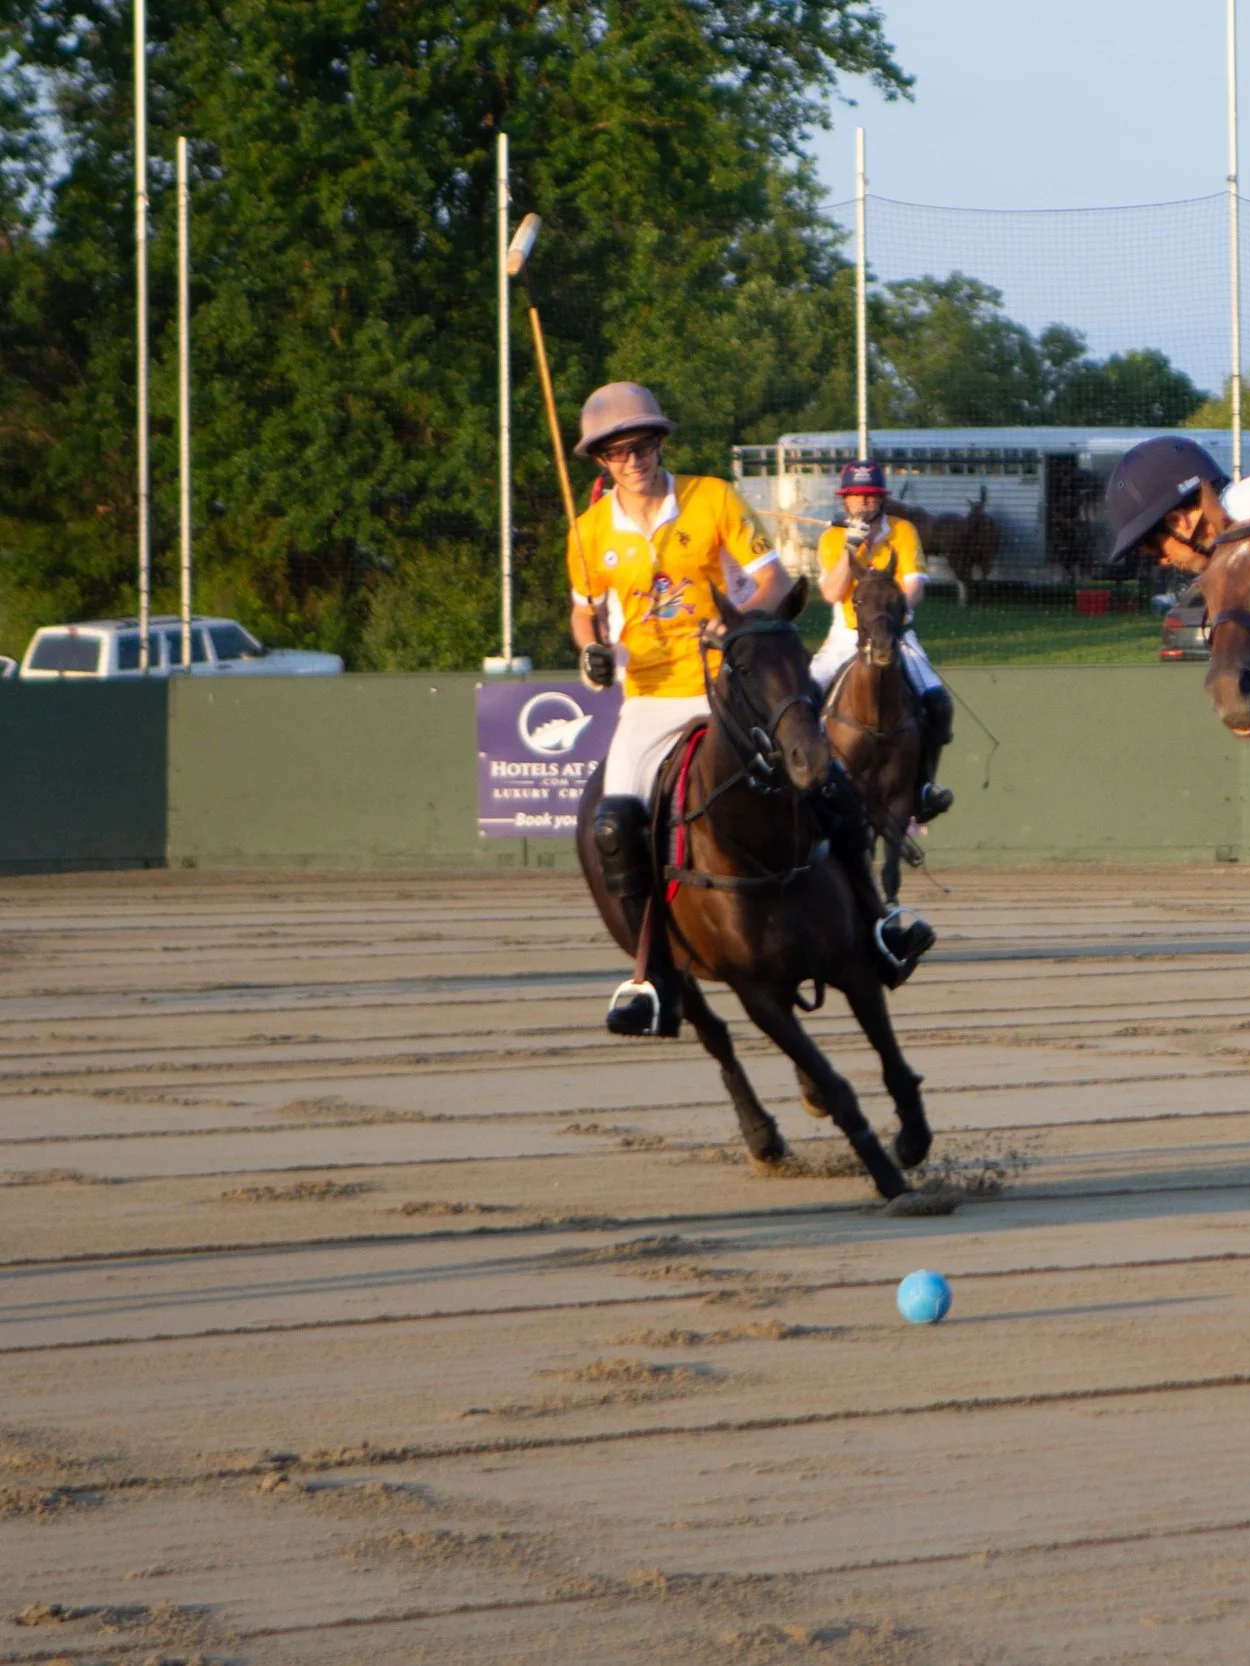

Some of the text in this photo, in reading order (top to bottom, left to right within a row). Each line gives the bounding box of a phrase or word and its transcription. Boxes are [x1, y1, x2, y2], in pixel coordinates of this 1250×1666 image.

[491, 760, 560, 777] HOTELS
[562, 762, 585, 777] AT
[493, 788, 550, 799] LUXURY
[515, 812, 552, 827] Book
